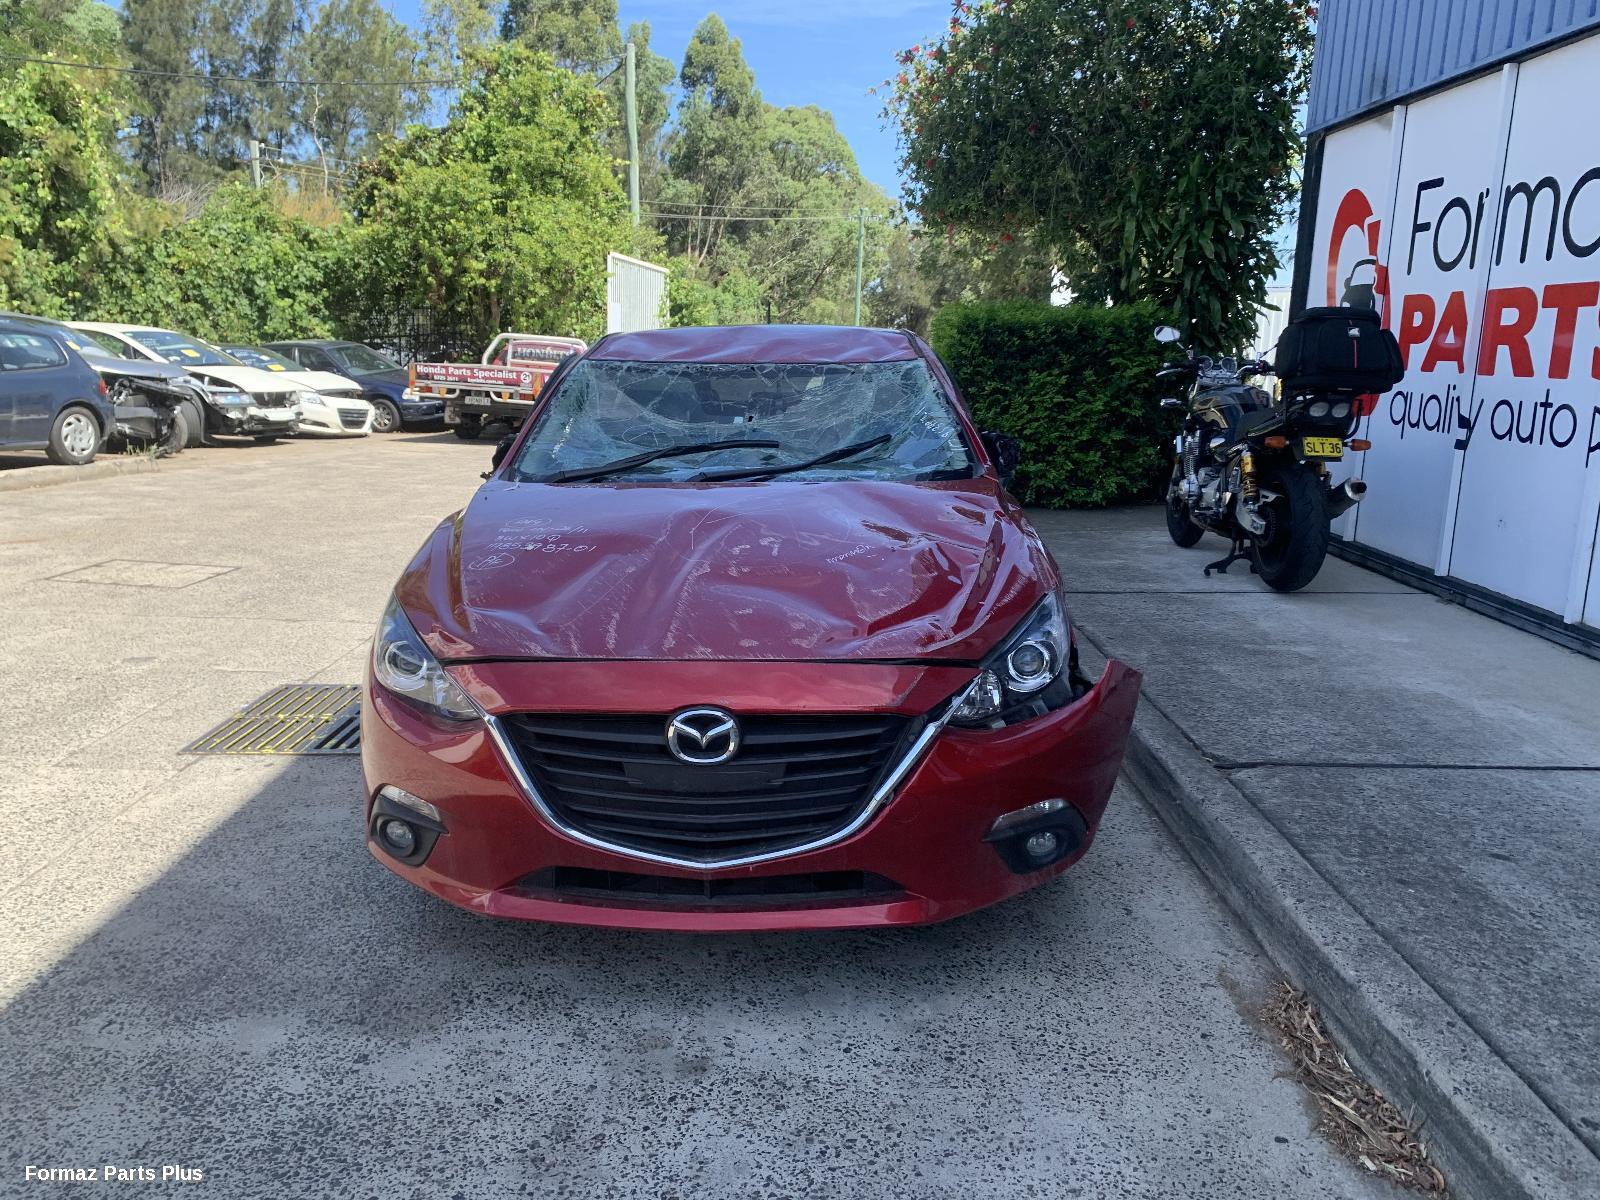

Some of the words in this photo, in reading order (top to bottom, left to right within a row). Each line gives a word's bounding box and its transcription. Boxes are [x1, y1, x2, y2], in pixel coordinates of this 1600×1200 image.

[1399, 281, 1600, 379] PART
[416, 365, 445, 374] Honda
[448, 366, 471, 376] Parts
[473, 368, 517, 379] Specialist
[1490, 388, 1578, 448] auto
[1306, 442, 1325, 454] SLT
[1328, 443, 1341, 454] 36
